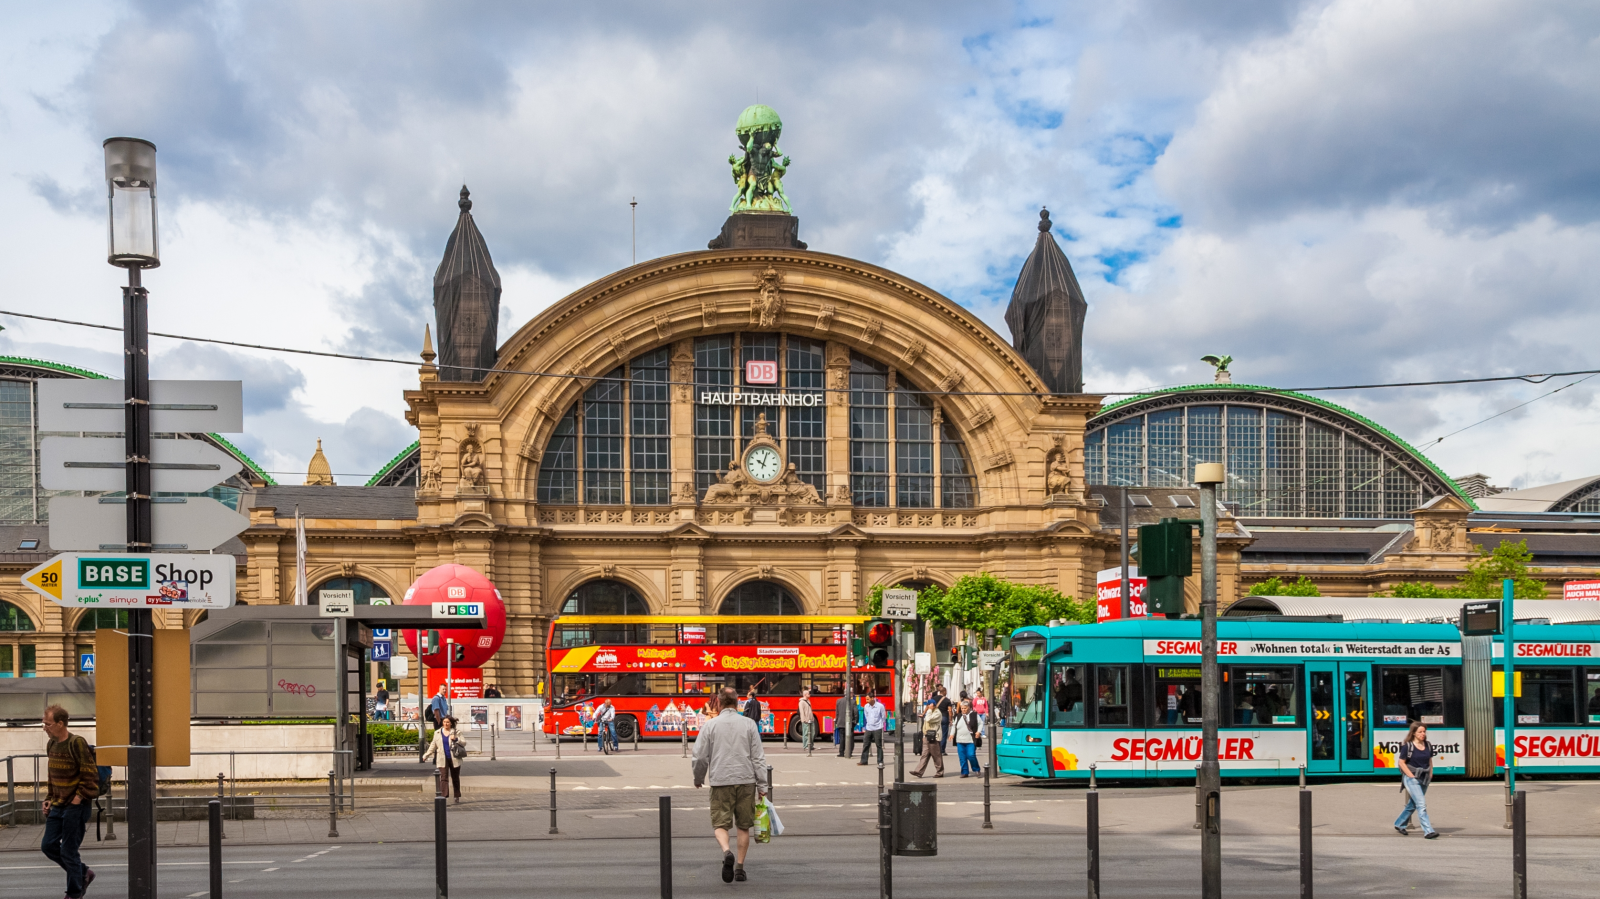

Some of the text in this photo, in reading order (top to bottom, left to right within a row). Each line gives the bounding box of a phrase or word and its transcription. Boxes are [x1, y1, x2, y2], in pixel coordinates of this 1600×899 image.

[750, 365, 774, 380] DB
[701, 392, 823, 406] HAUPTBAHNHOF
[41, 572, 58, 583] 50
[86, 562, 213, 590] BASE Shop
[109, 596, 138, 605] simyo
[460, 606, 477, 614] S U
[1098, 604, 1110, 618] Rot.
[480, 637, 492, 646] DB
[1333, 644, 1344, 654] in
[1346, 644, 1402, 654] Weiterstadt
[1418, 645, 1434, 654] der
[1436, 645, 1450, 656] A5
[1517, 642, 1592, 656] SEGMÜLLER
